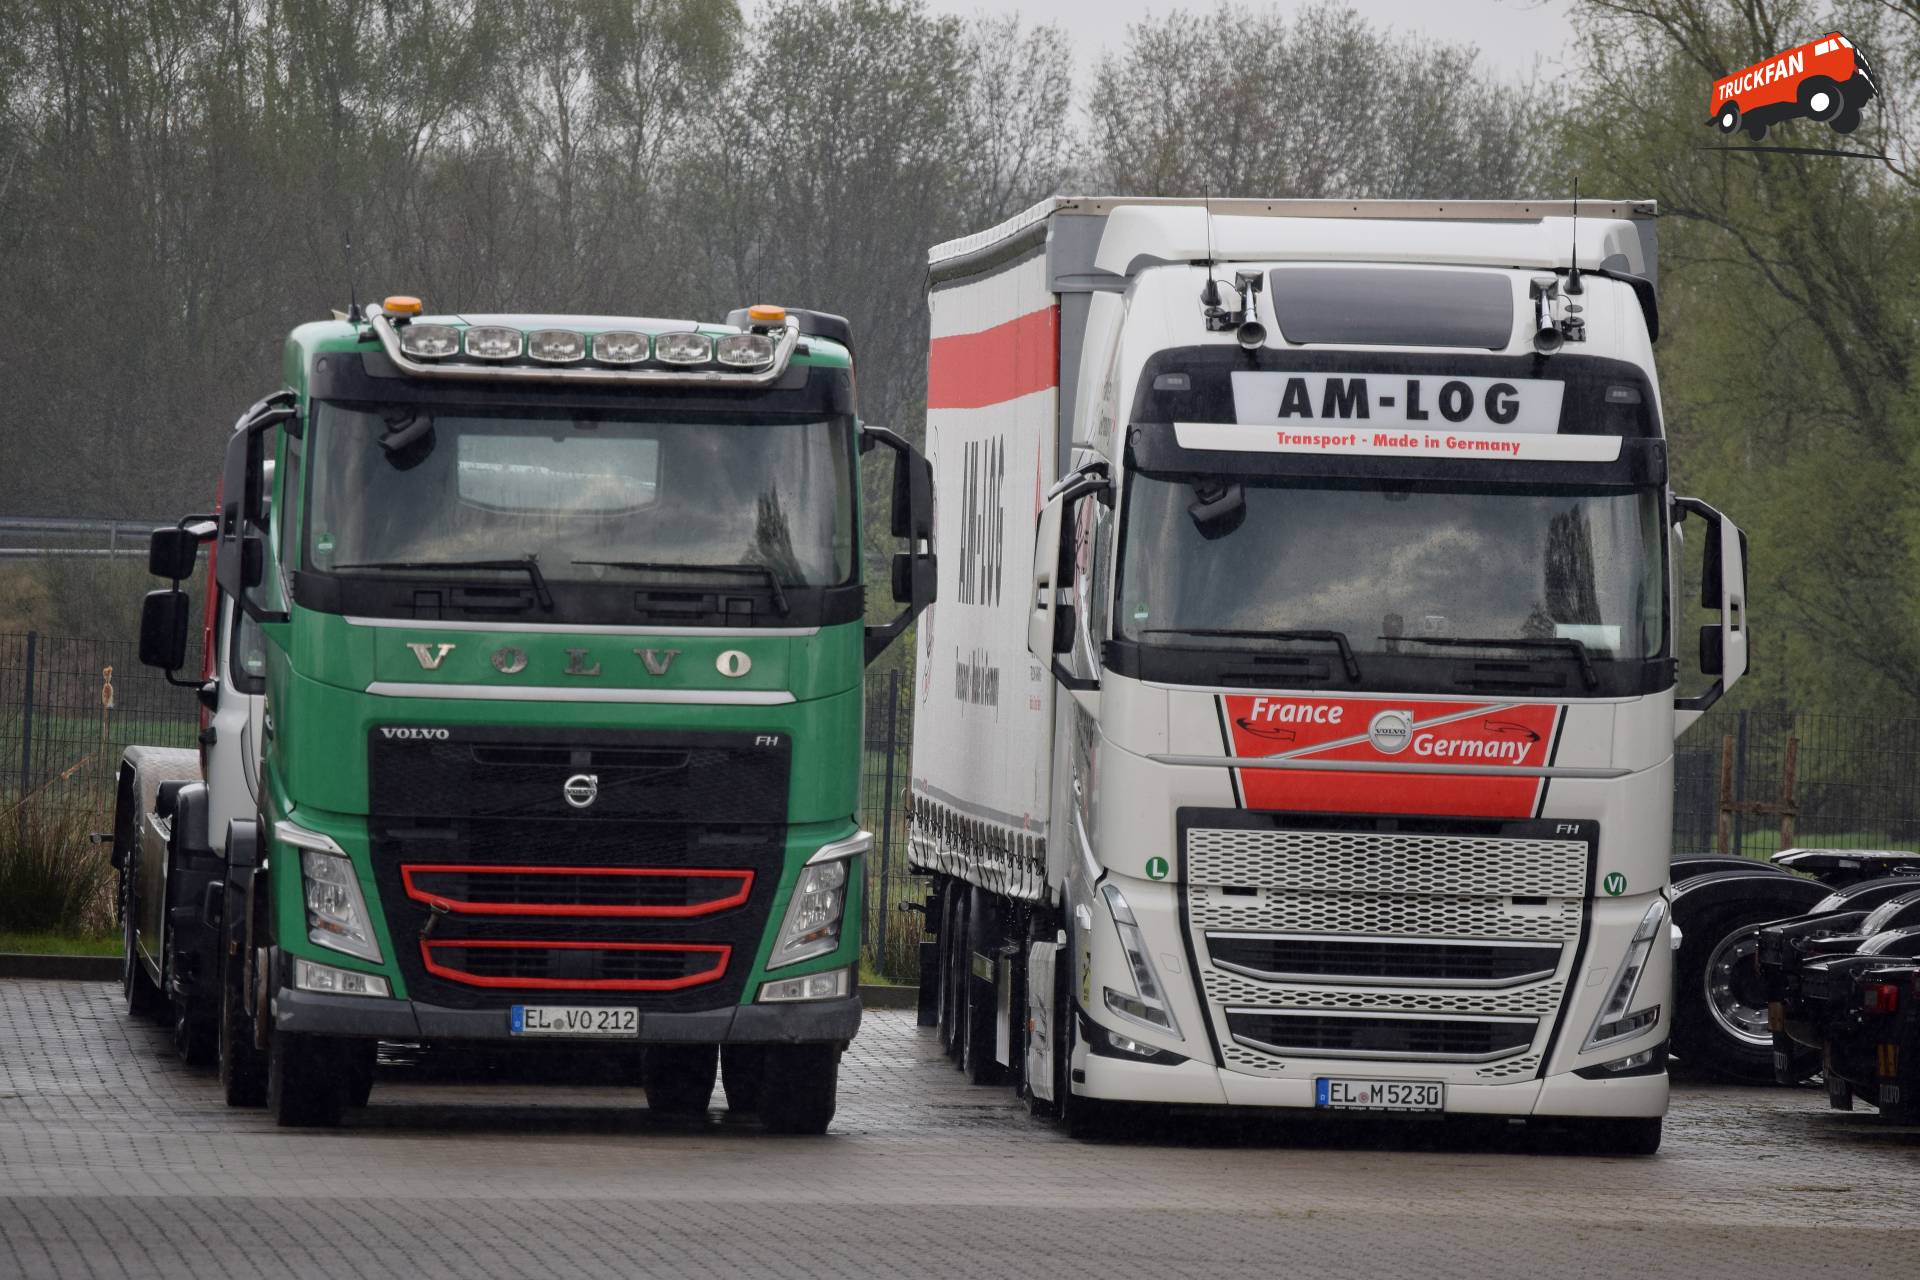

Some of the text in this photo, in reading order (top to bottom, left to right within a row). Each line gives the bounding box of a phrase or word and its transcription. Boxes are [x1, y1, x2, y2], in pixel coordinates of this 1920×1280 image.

[1277, 377, 1520, 425] AM-LOG
[1277, 431, 1356, 449] Transport
[1373, 433, 1419, 448] Made
[1424, 435, 1440, 449] in
[1446, 436, 1521, 456] Germany
[406, 643, 753, 679] VOLVO
[1250, 697, 1344, 725] France
[381, 728, 449, 740] VOLVO
[755, 736, 779, 746] FH
[1413, 733, 1532, 765] Germany
[1556, 823, 1580, 835] FH
[1152, 858, 1165, 877] L
[1607, 876, 1624, 893] VI
[525, 1009, 636, 1030] EL VO 212
[1330, 1083, 1439, 1106] EL M 5230
